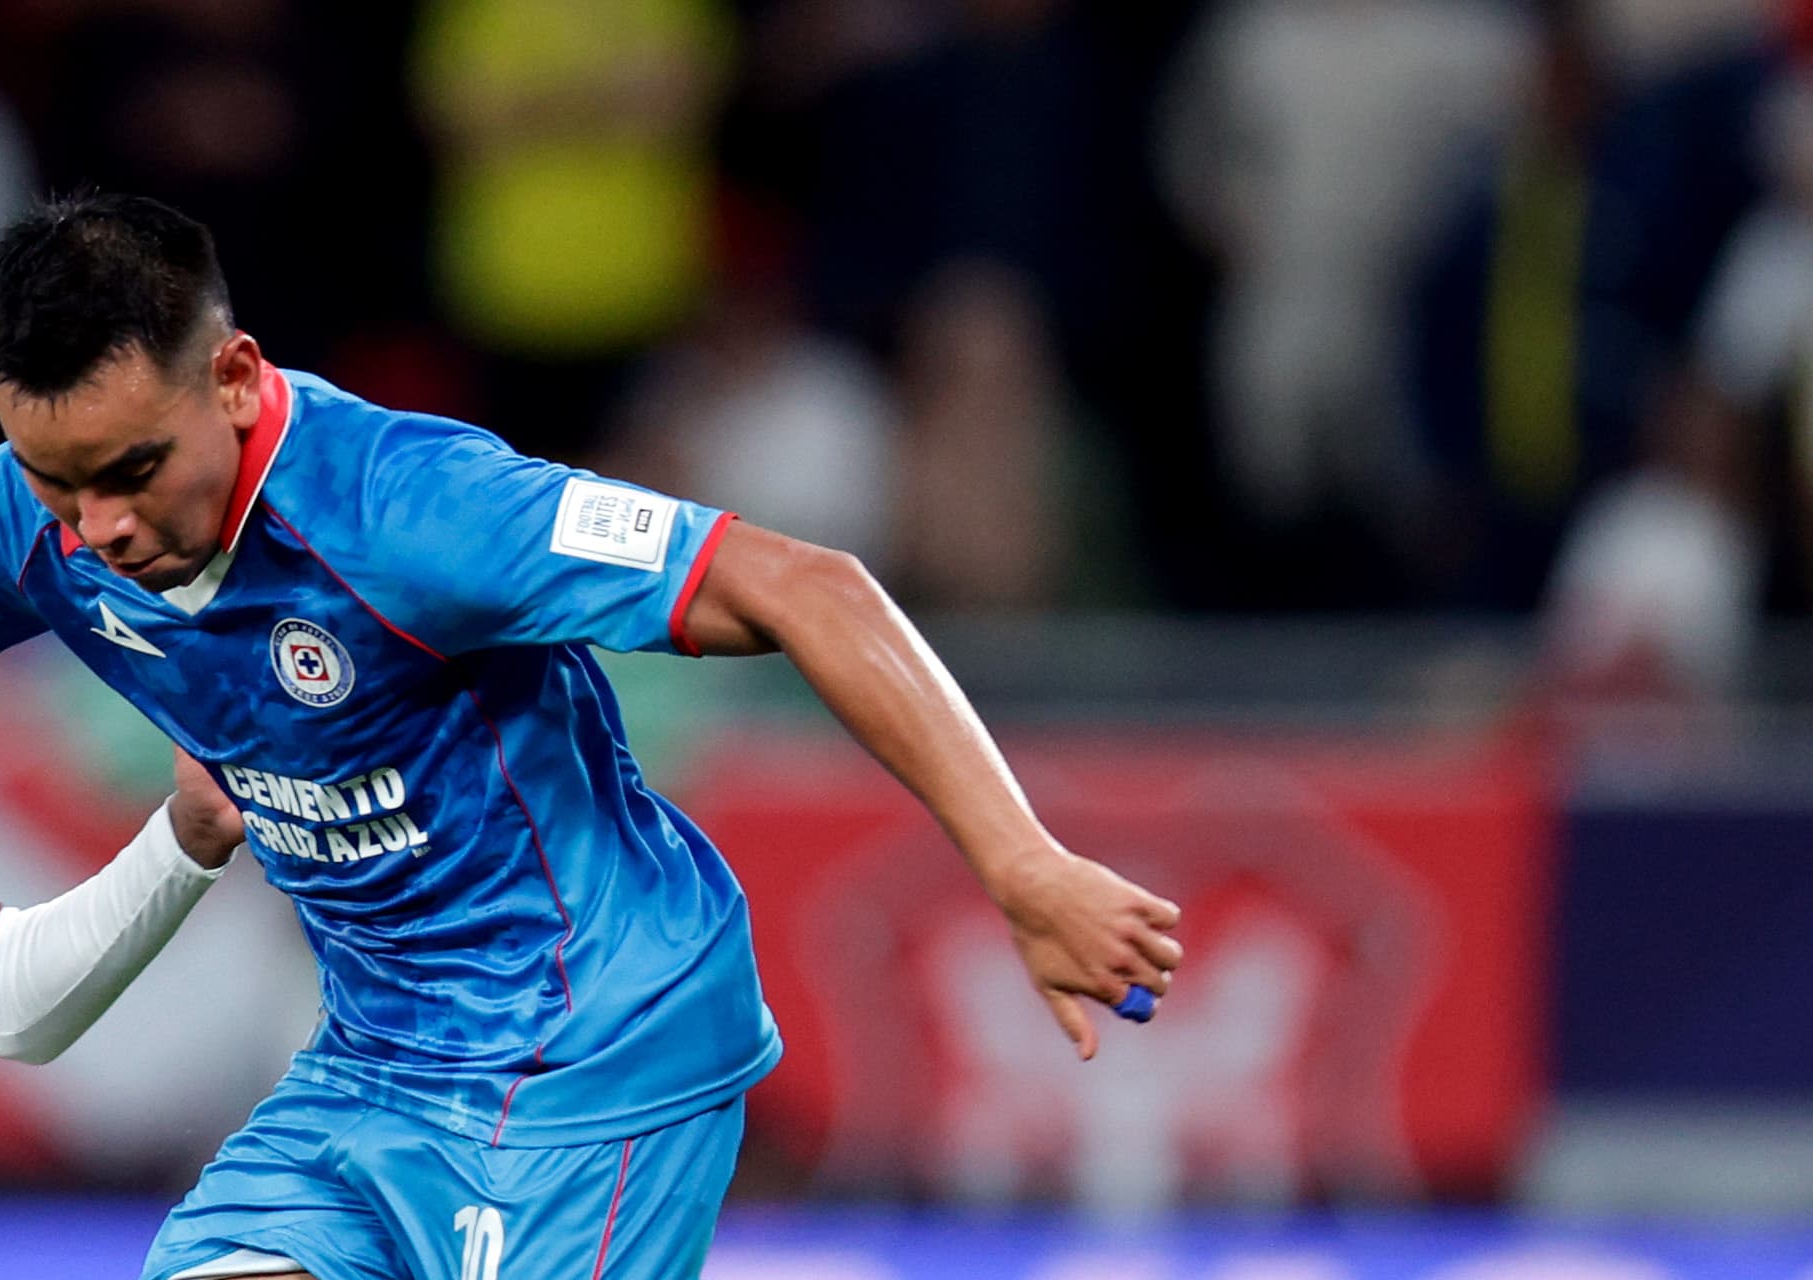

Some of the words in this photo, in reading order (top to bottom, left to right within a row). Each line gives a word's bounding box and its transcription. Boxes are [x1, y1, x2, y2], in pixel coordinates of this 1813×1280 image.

[591, 495, 619, 538] UNITES
[221, 764, 405, 822] CEMENTO
[241, 811, 329, 862] CRUZ
[325, 812, 428, 862] AZUL
